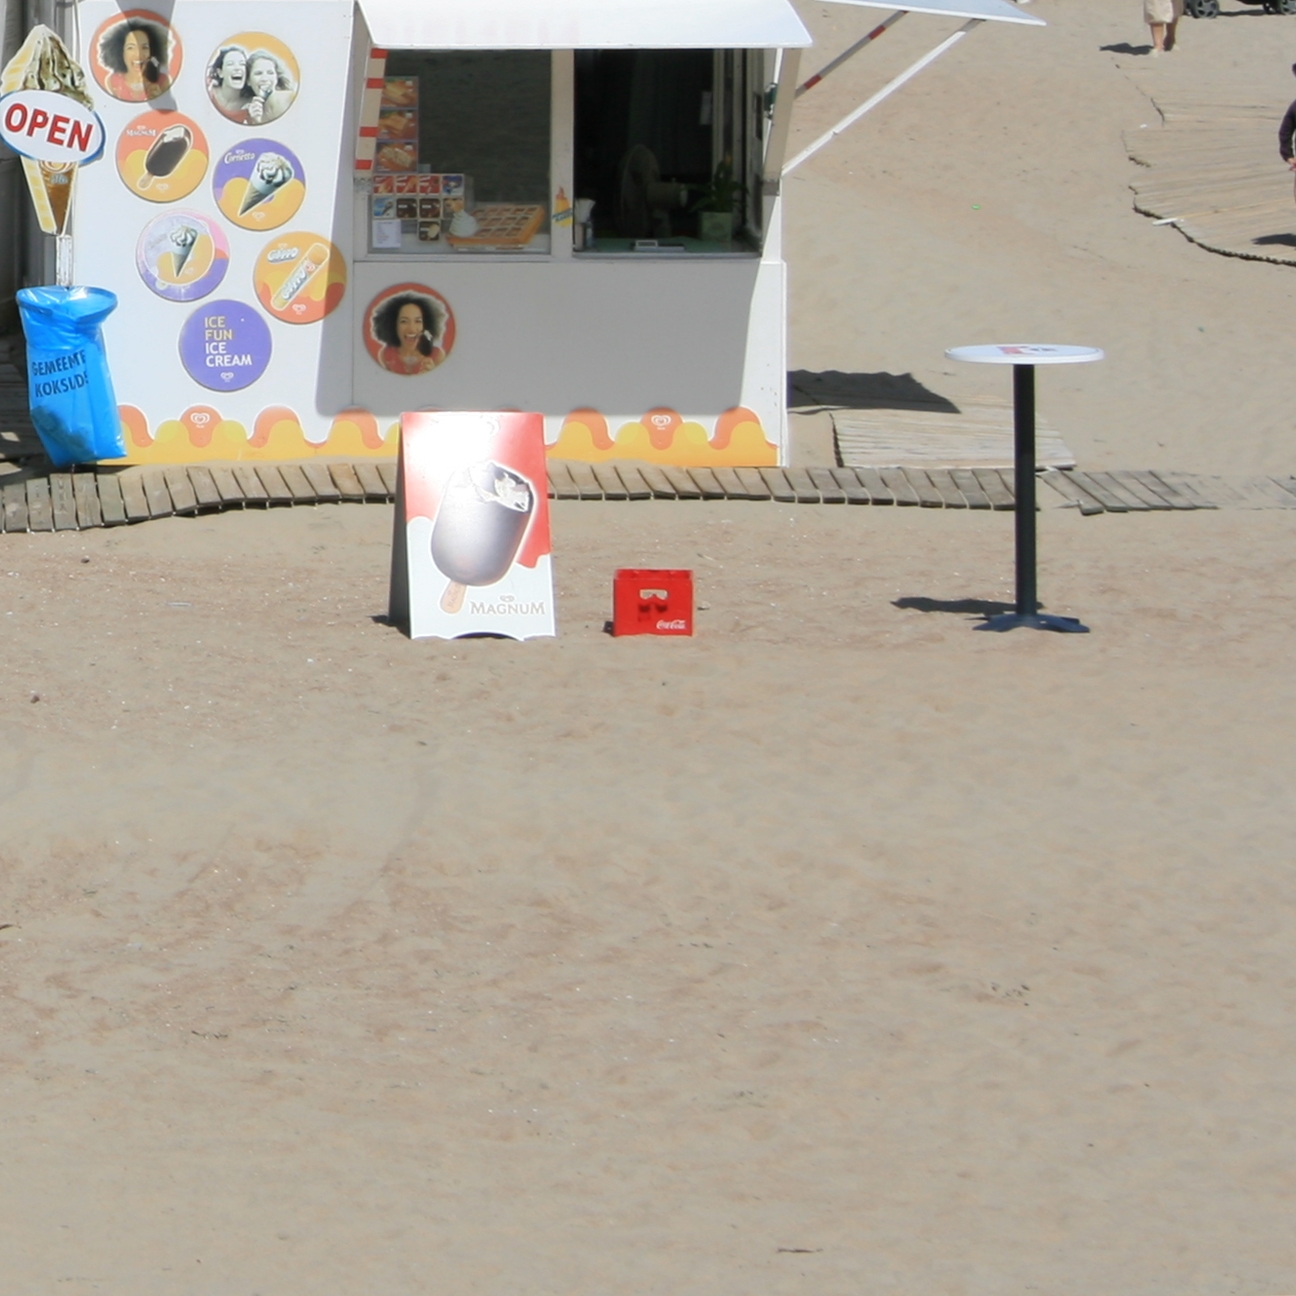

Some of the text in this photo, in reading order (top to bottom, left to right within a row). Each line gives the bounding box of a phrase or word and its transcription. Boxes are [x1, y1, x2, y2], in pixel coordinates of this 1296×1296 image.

[5, 103, 93, 152] OPEN
[204, 316, 226, 328] ICE
[205, 329, 233, 341] FUN
[205, 342, 227, 354] ICE
[206, 355, 253, 367] CREAM
[470, 601, 546, 615] MAGNUM
